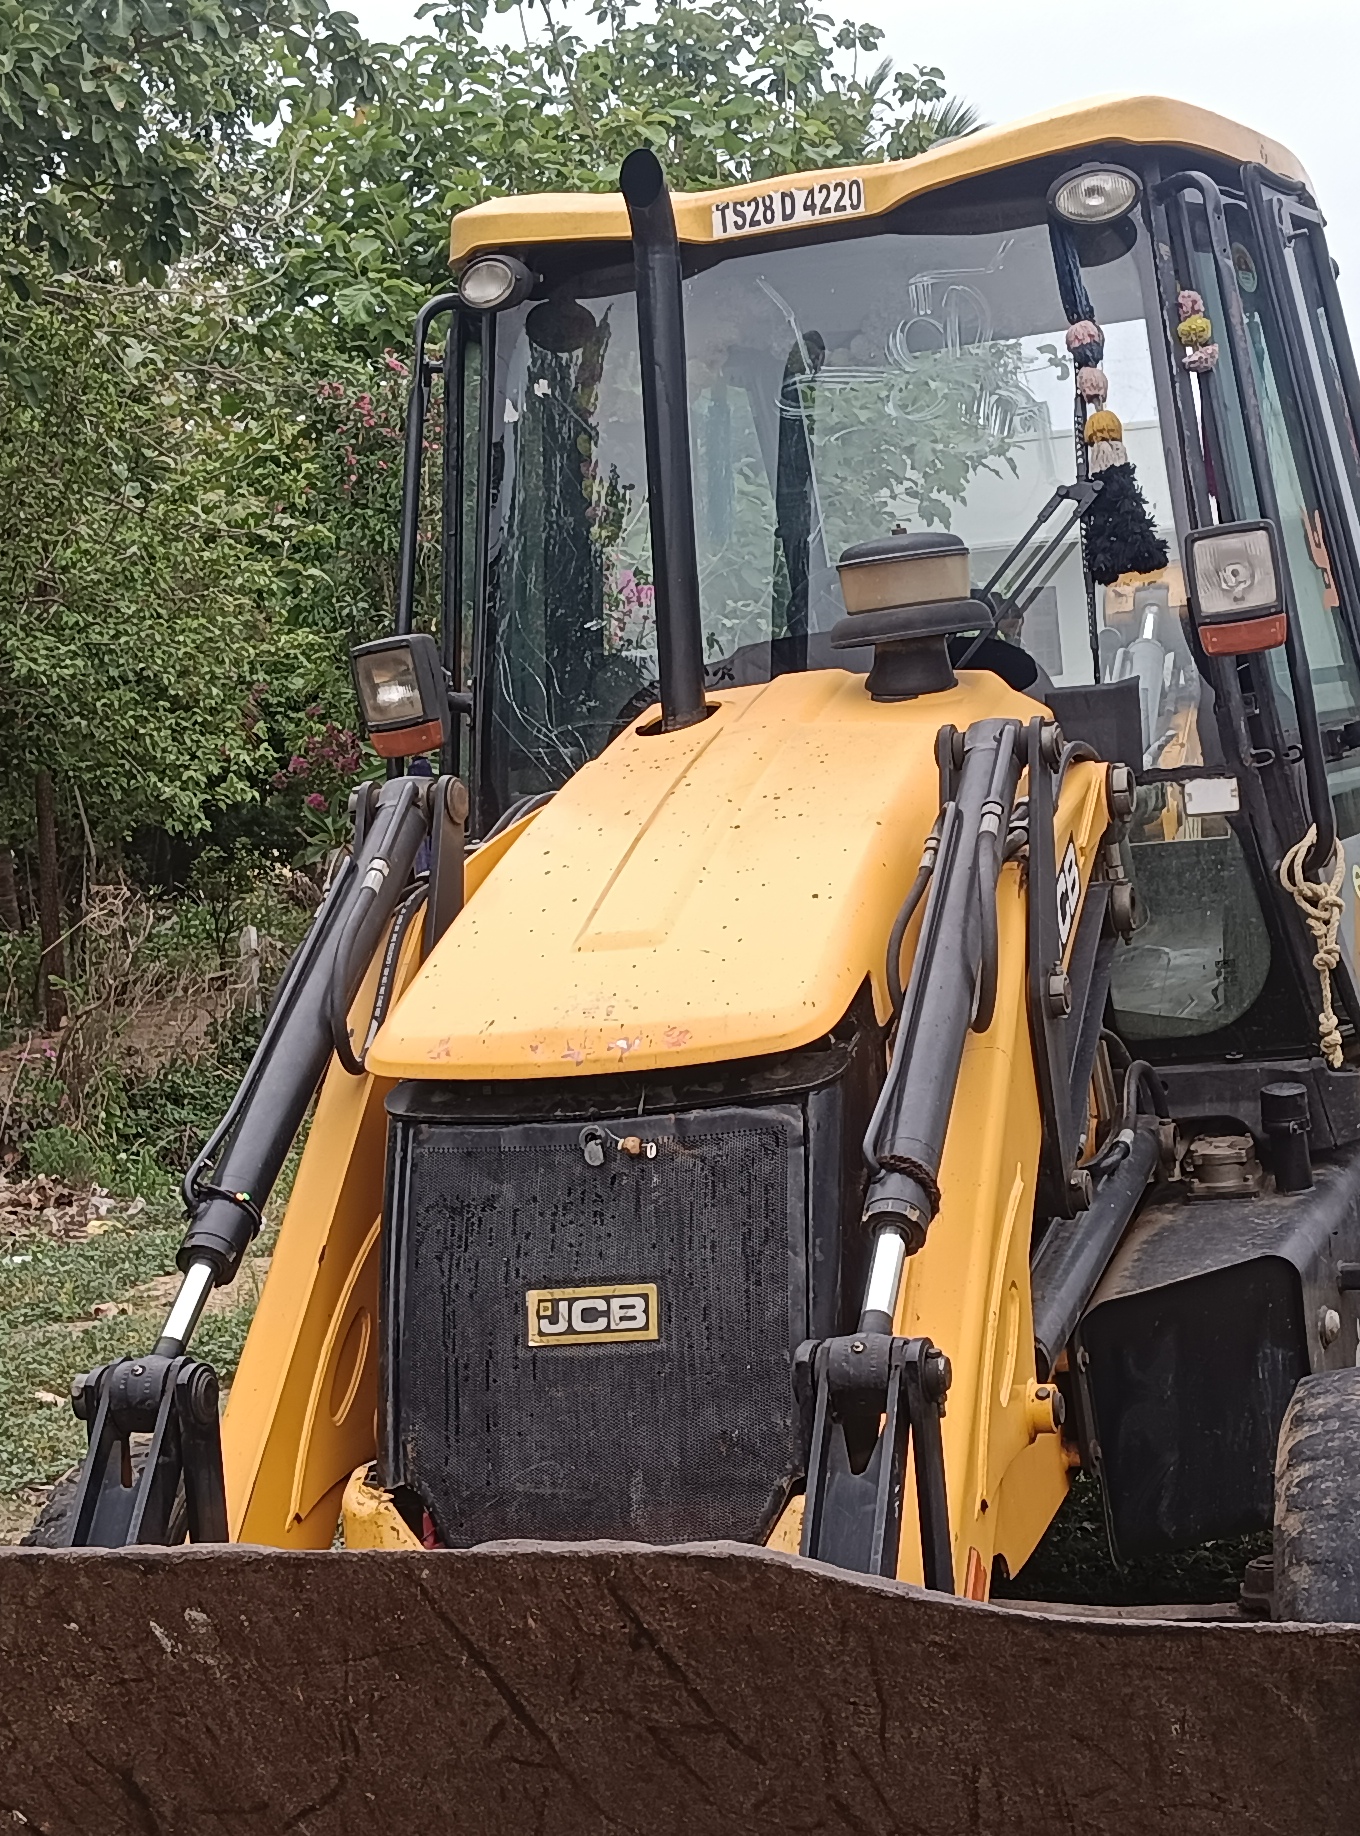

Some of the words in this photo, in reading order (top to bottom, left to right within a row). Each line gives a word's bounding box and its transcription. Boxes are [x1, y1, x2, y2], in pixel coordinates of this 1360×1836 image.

[715, 194, 775, 234] TS28
[780, 190, 796, 222] D
[802, 179, 862, 217] 4220
[1056, 842, 1080, 959] CB
[539, 1296, 647, 1334] JCB
